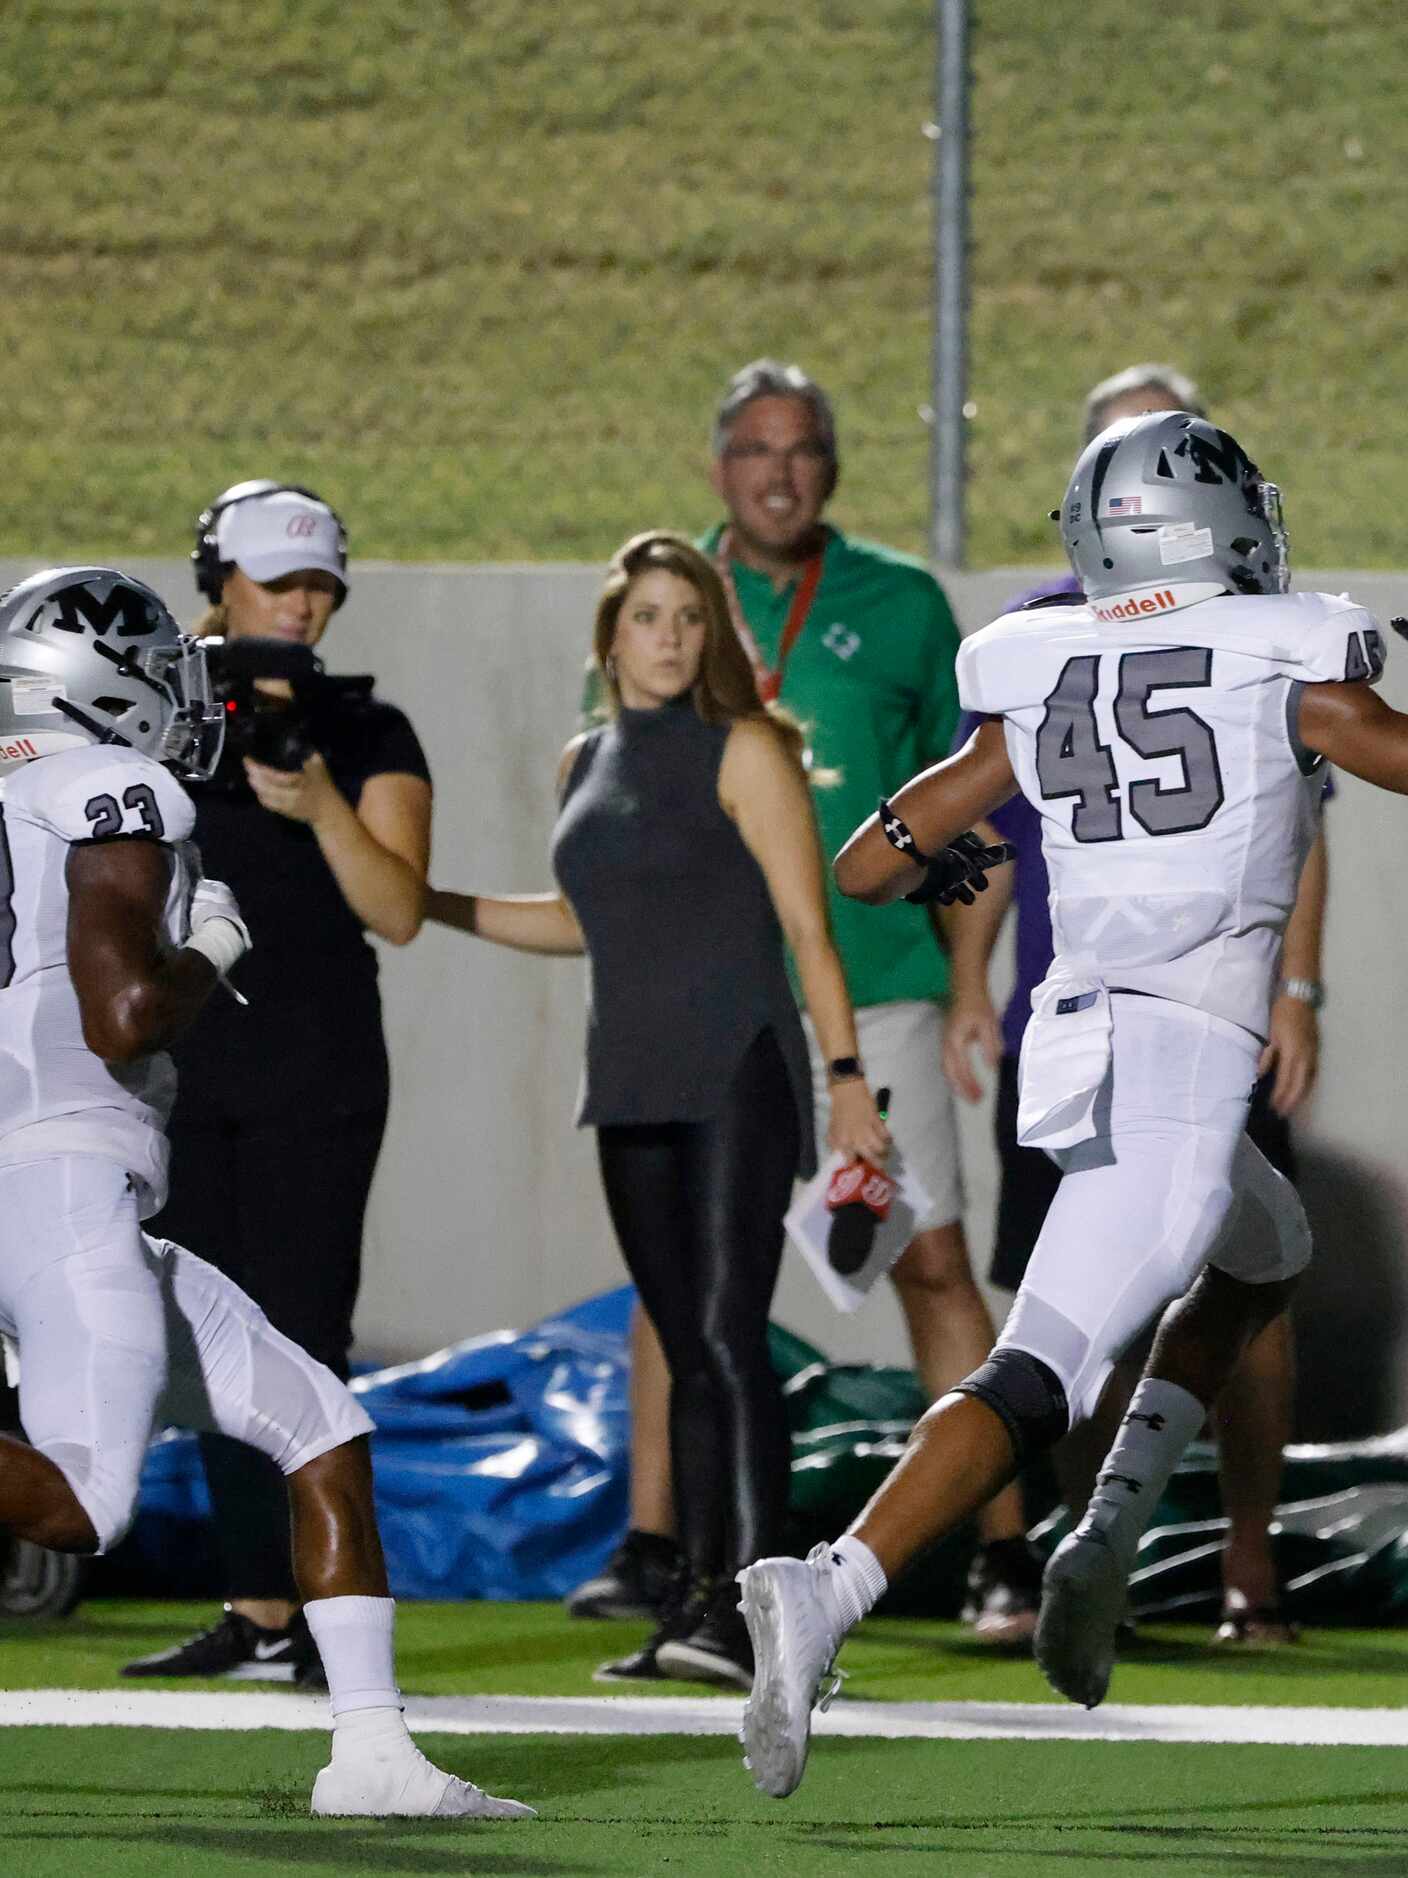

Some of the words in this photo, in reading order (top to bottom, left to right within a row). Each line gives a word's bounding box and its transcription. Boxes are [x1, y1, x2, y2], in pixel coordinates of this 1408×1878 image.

[48, 580, 163, 637] M
[1035, 646, 1226, 843] 45
[84, 782, 164, 840] 23
